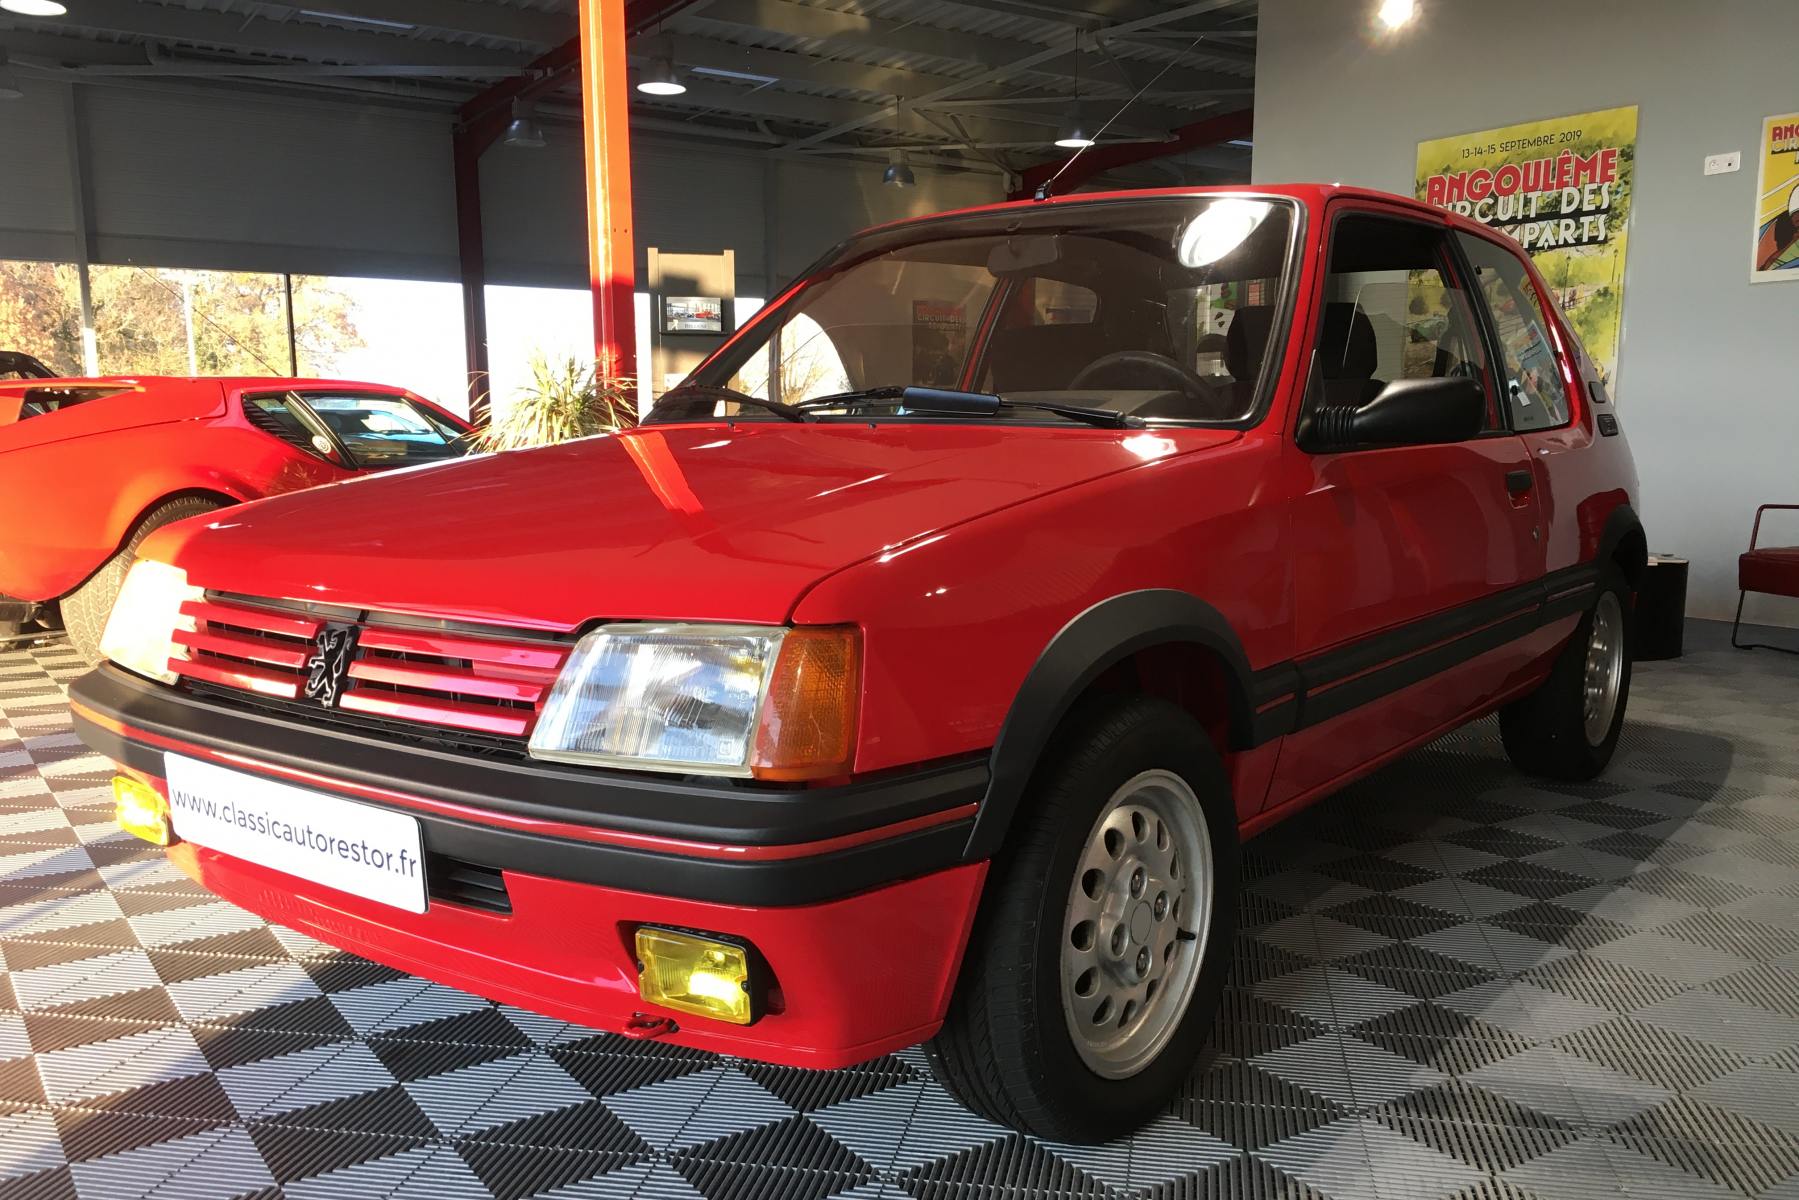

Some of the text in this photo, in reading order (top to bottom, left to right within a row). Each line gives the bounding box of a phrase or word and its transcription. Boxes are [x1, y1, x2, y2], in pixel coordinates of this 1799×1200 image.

[1462, 129, 1583, 159] 13-14-15 SEPTEMBRE 2019
[1426, 148, 1619, 206] ANGOULÊME
[1435, 181, 1612, 224] RCUIT DES
[172, 787, 418, 878] www.classicautorestor.fr
